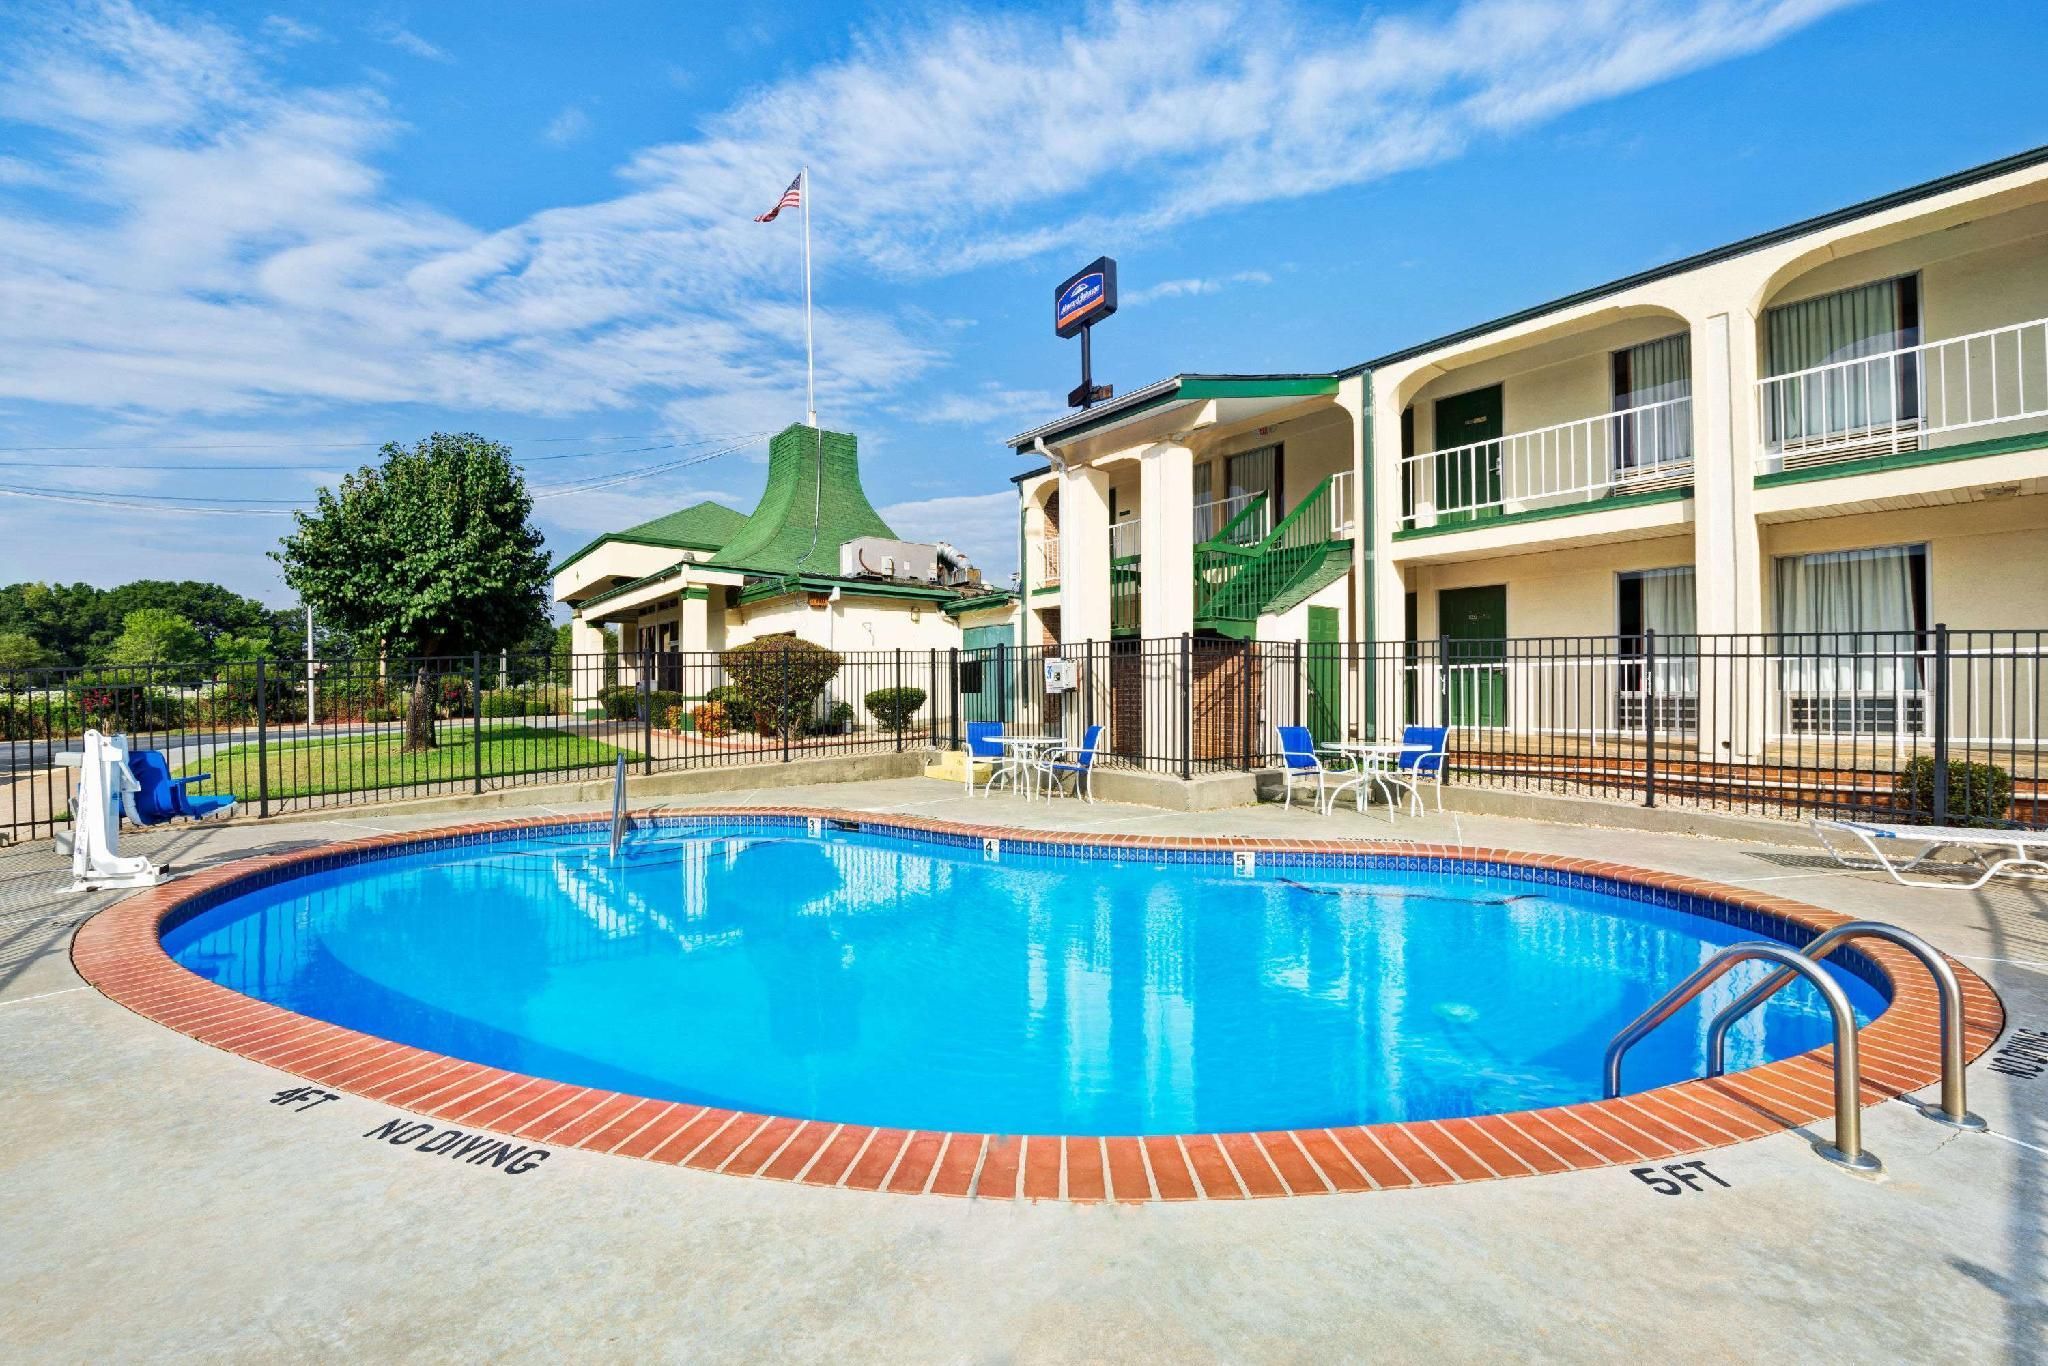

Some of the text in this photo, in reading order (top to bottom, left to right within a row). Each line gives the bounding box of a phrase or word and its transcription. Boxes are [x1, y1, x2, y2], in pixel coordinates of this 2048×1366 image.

[985, 840, 993, 851] 4
[1236, 854, 1246, 867] 5
[1986, 1057, 2045, 1080] NO
[269, 1086, 341, 1112] 4FT
[362, 1118, 551, 1175] NO DIVING
[1629, 1160, 1732, 1196] 5FT
